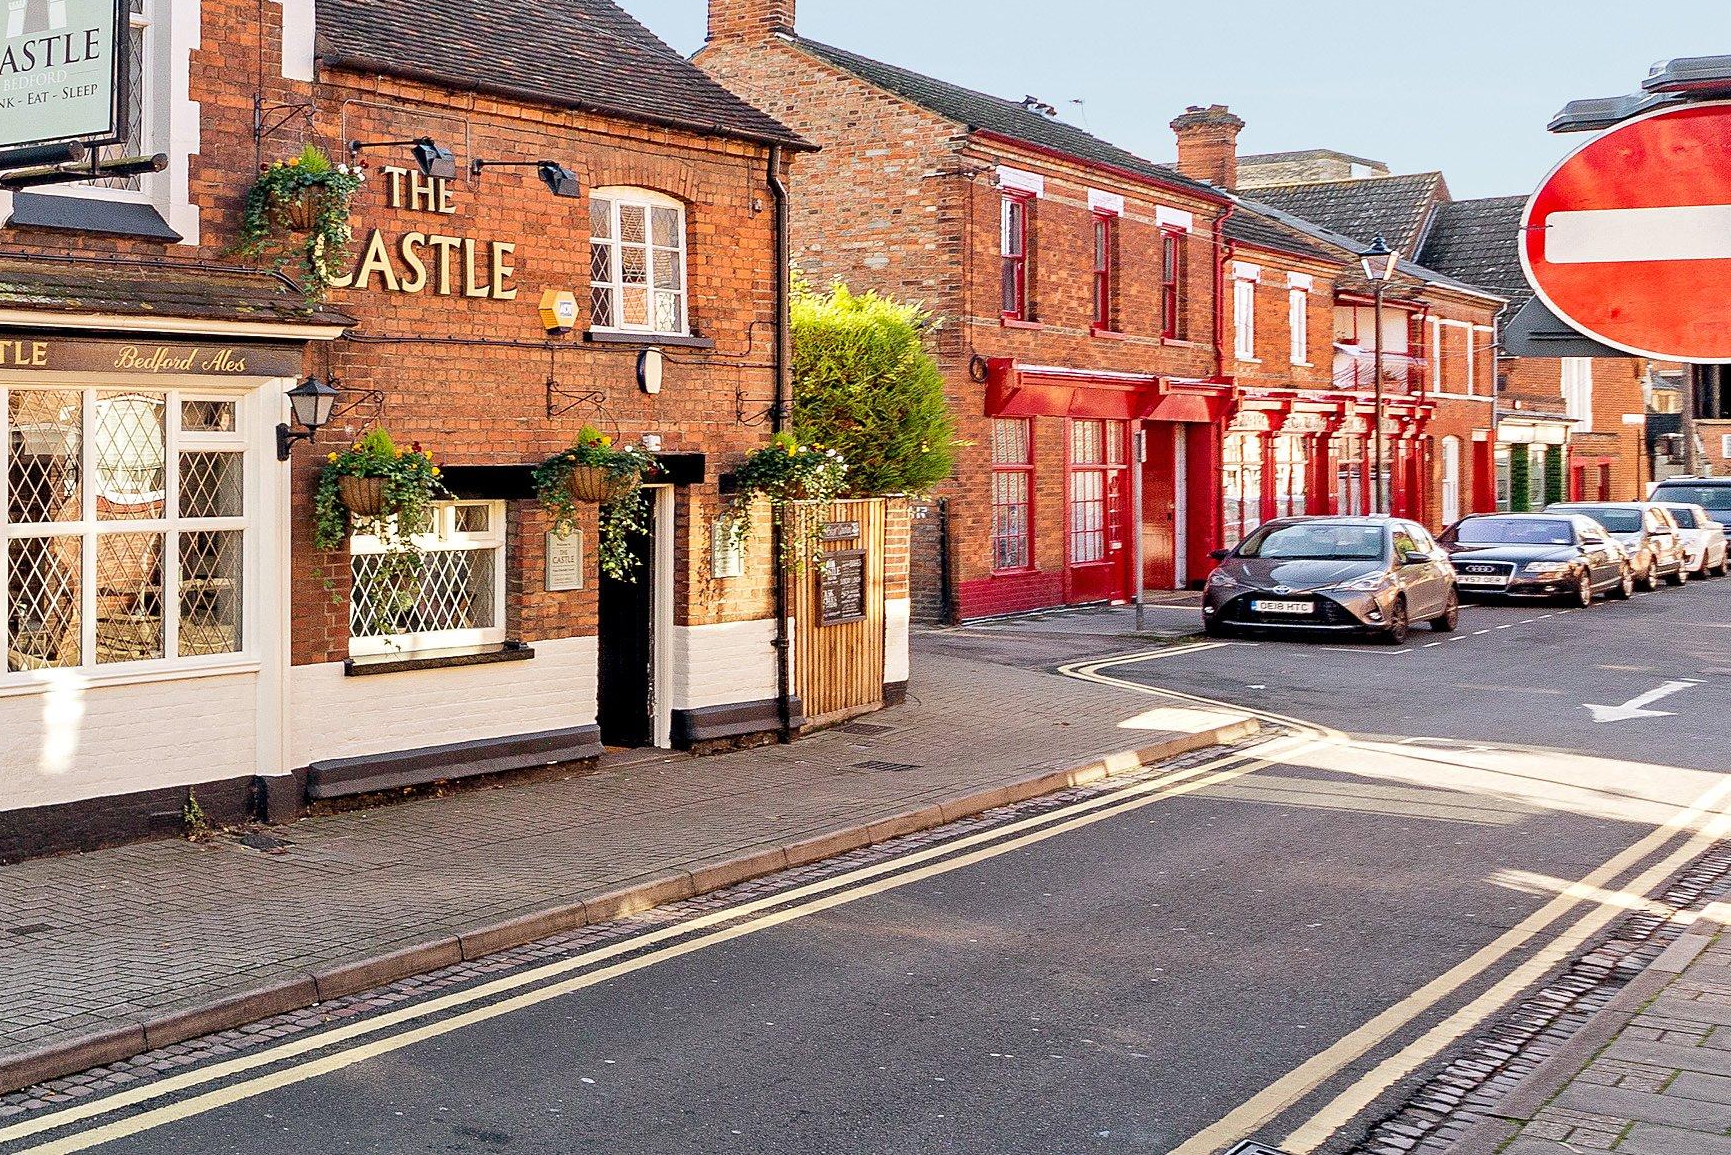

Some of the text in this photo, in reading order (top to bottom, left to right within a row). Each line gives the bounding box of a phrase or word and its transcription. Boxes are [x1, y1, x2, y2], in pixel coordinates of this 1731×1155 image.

[4, 69, 68, 91] BEDFORD
[28, 91, 50, 105] EAT
[61, 83, 98, 99] SLEEP
[384, 165, 457, 214] THE
[114, 346, 247, 373] Bedford Ales
[552, 555, 574, 564] CASTLE
